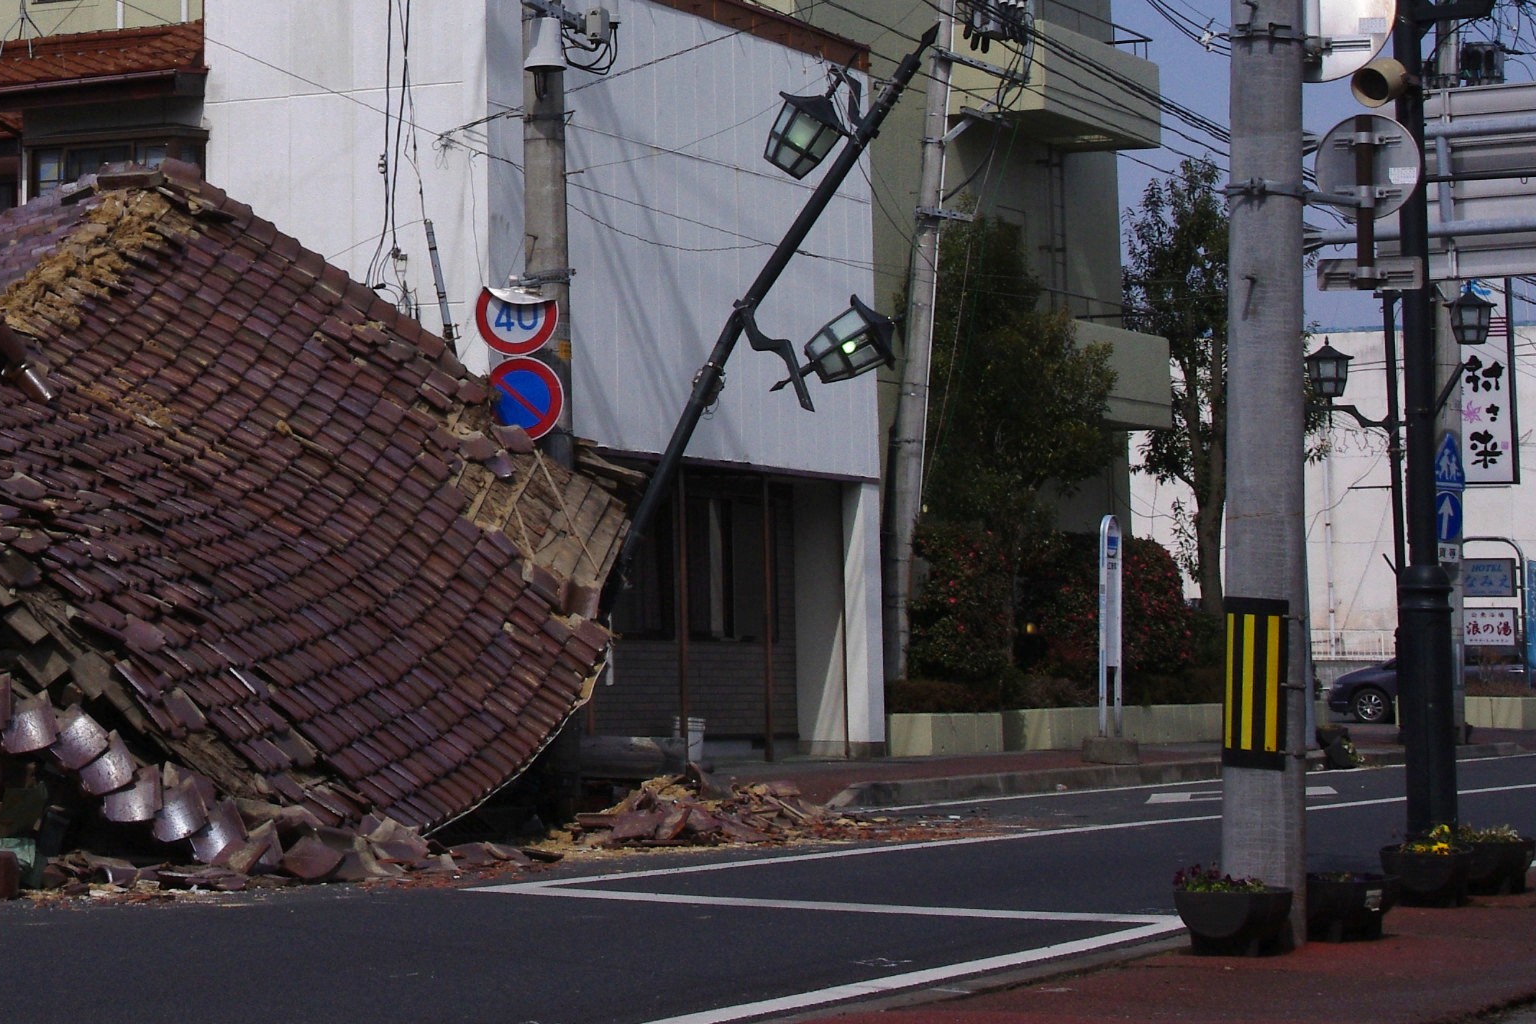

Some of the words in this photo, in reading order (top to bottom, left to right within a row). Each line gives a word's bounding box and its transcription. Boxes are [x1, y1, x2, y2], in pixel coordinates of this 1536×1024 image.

[494, 303, 538, 332] 40
[1464, 354, 1505, 469] 村さ来
[1471, 563, 1503, 572] HOTEL
[1465, 573, 1510, 588] なみえ
[1466, 620, 1513, 637] 浪の湯
